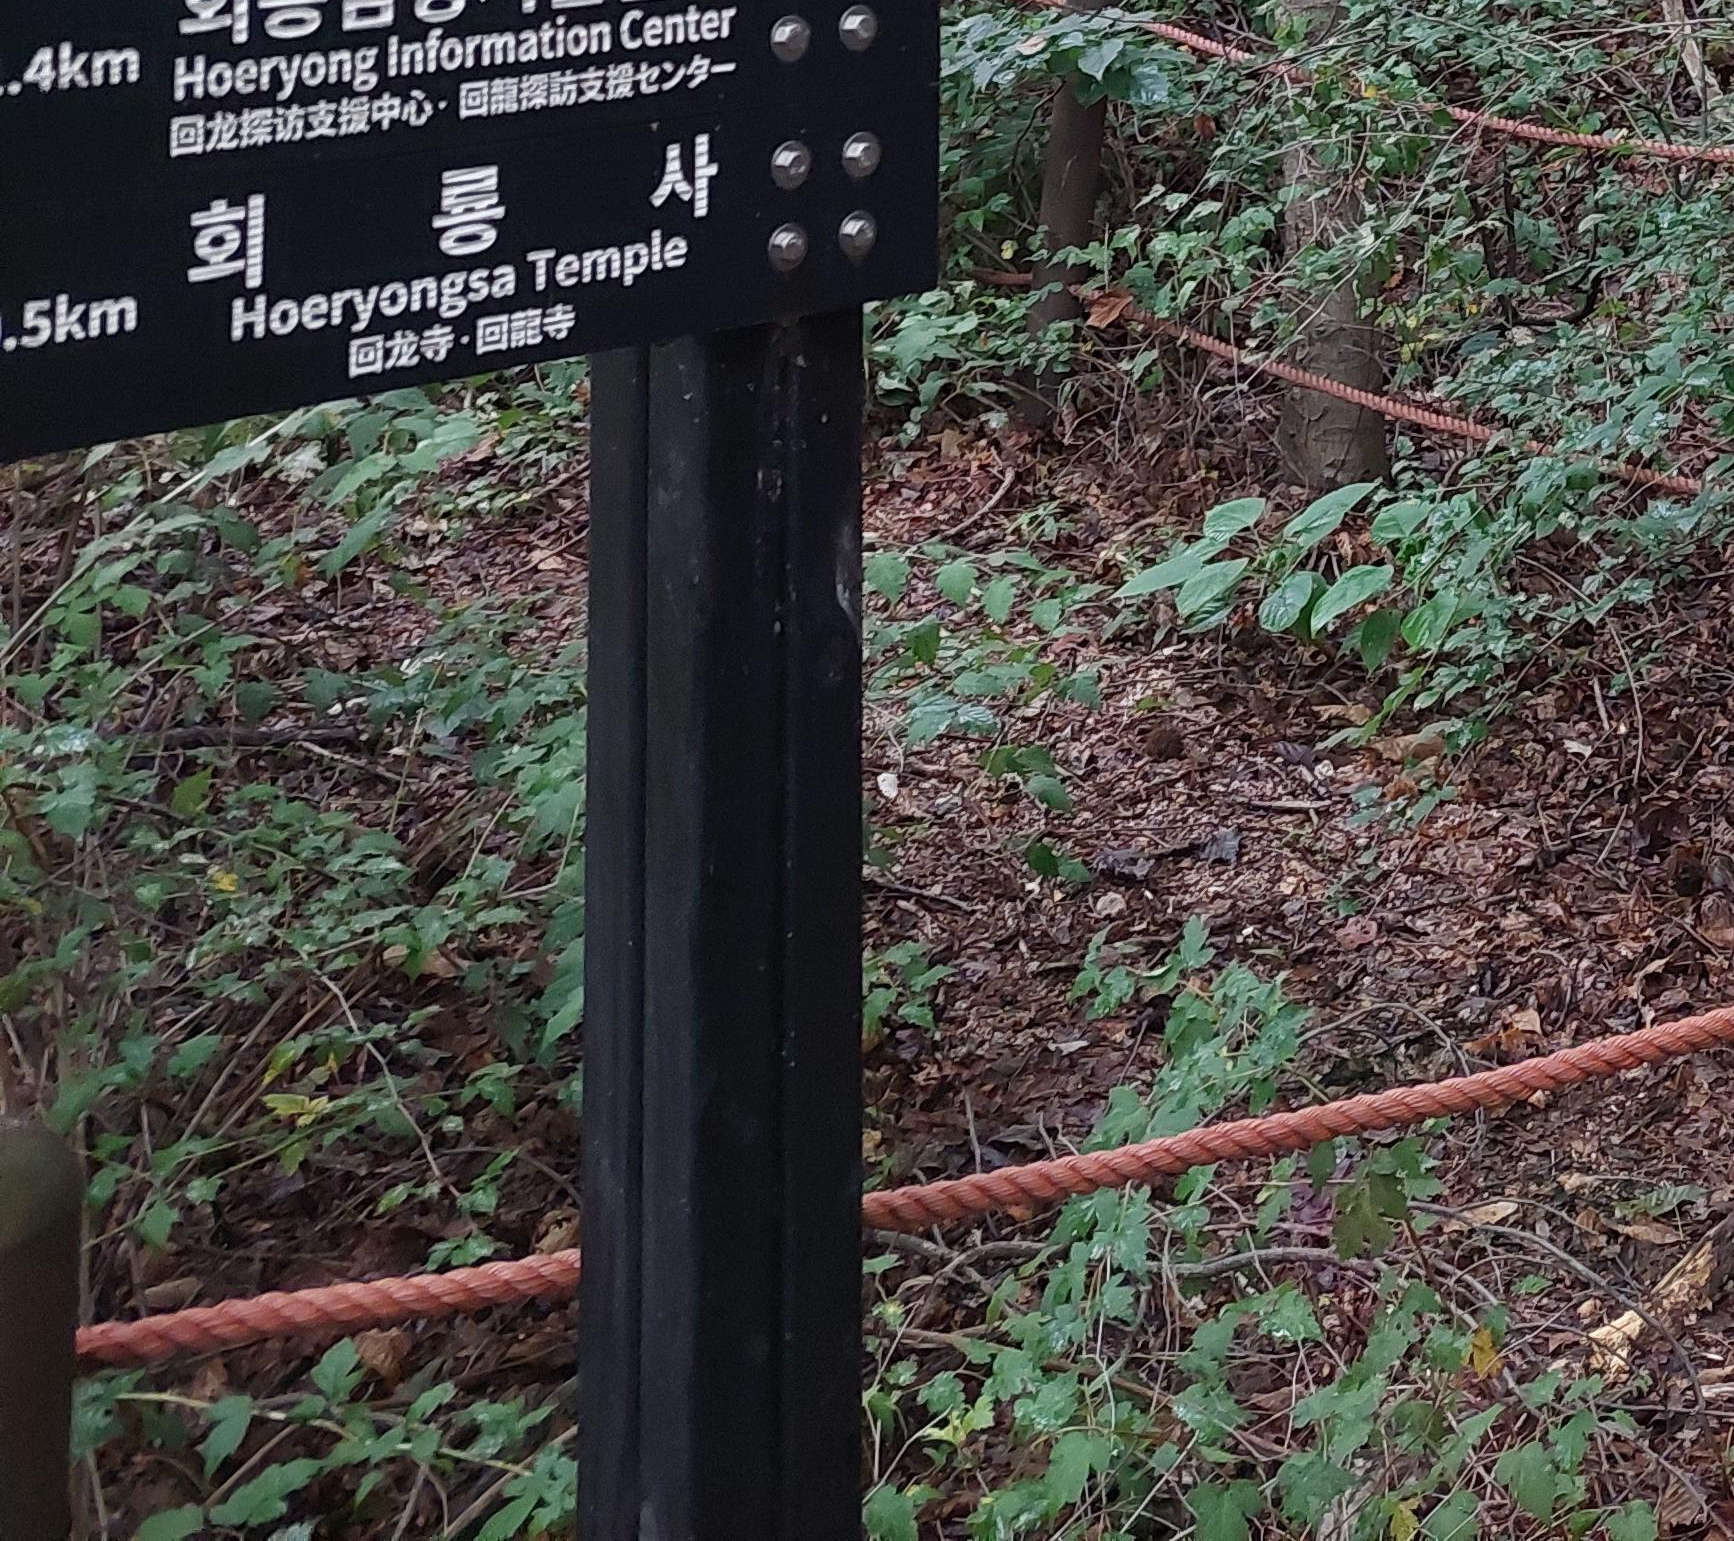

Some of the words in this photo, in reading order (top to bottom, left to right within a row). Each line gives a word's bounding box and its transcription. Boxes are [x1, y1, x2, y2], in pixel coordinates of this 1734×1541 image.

[0, 41, 140, 97] .4km
[173, 46, 379, 102] Hoeryong
[387, 14, 612, 77] Information
[619, 4, 737, 50] Center
[0, 293, 138, 352] .5km
[230, 264, 516, 342] Hoeryongsa
[526, 228, 689, 292] Temple
